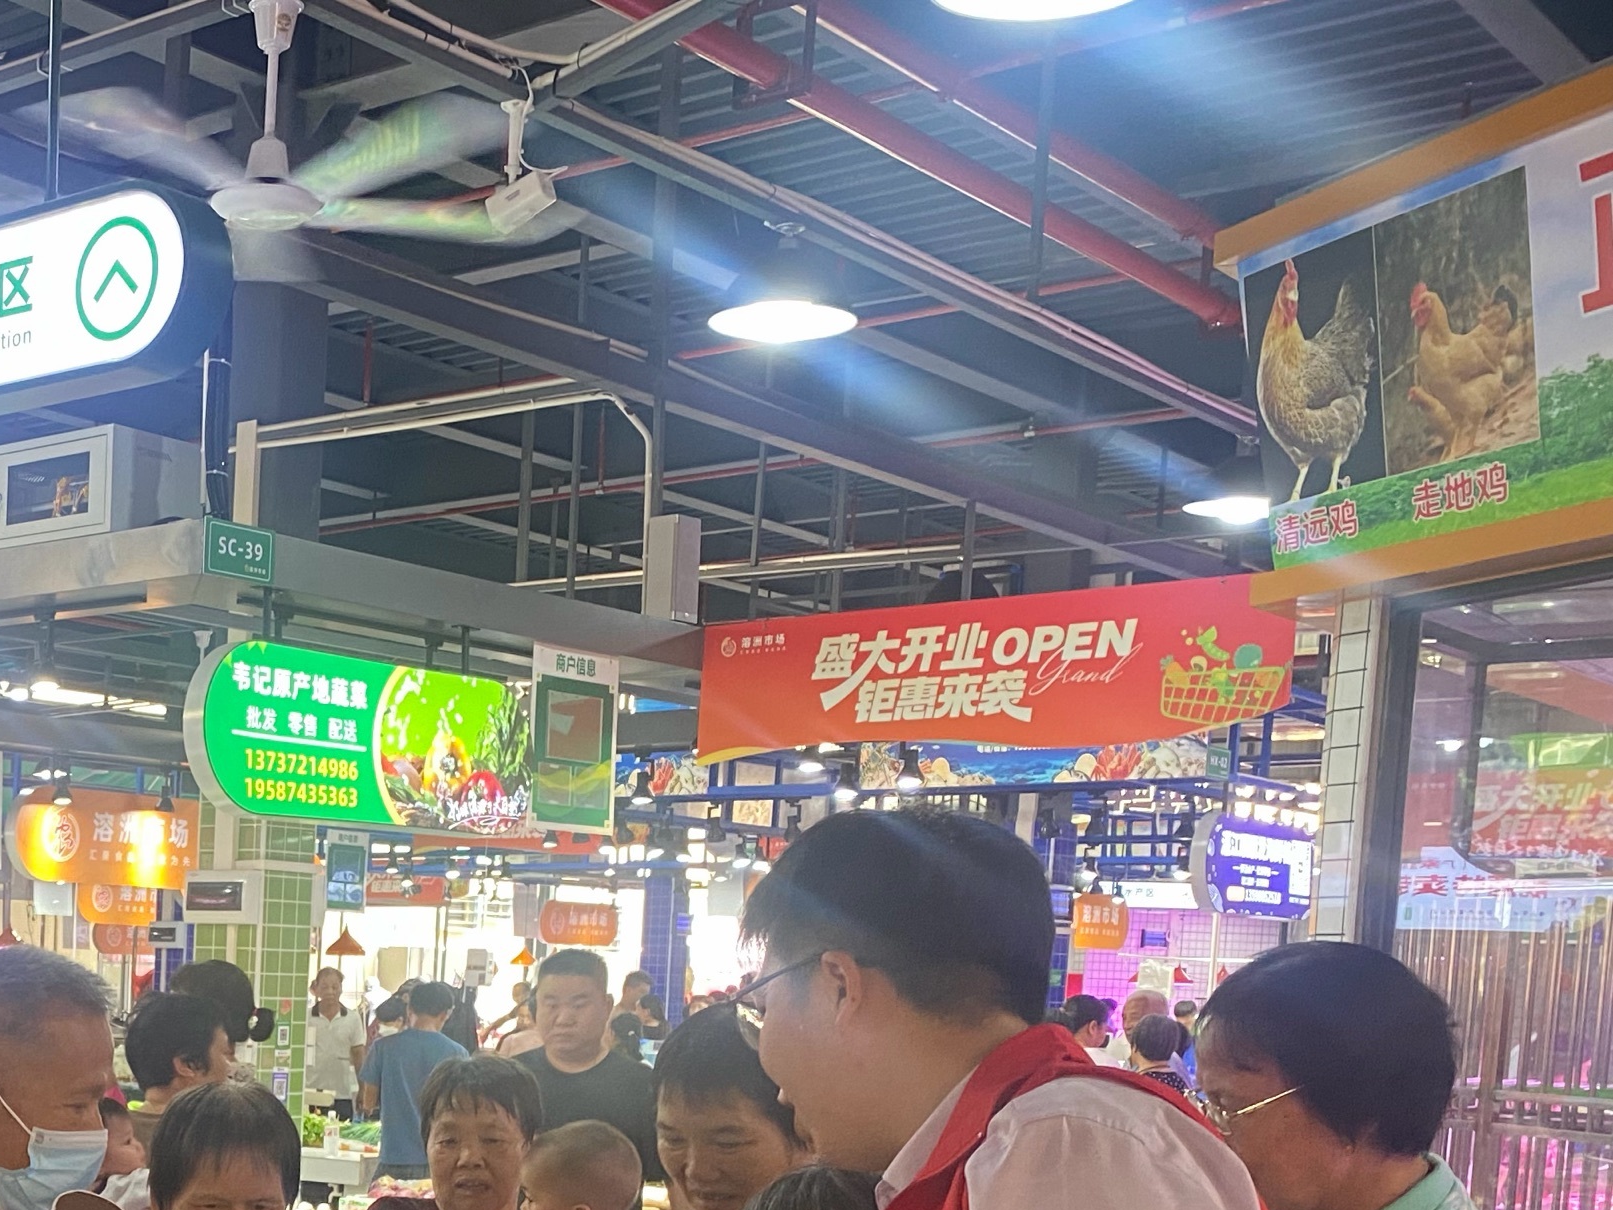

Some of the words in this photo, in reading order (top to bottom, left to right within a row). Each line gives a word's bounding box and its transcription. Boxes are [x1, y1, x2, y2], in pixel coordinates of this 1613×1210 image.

[1412, 462, 1510, 522] 走地鸡
[218, 536, 264, 561] SC-39
[1274, 499, 1359, 553] 清远鸡
[232, 661, 368, 710] 韦记原产地蔬菜
[554, 653, 597, 677] 商户信息
[811, 622, 989, 712] 盛大开业
[992, 618, 1139, 666] OPEN
[1028, 642, 1145, 697] Grand
[855, 669, 1033, 723] 钜惠来袭
[246, 705, 277, 732] 批发
[288, 711, 318, 738] 零售
[328, 717, 358, 742] 配送
[245, 748, 359, 781] 13737214986
[245, 777, 359, 808] 19587435363
